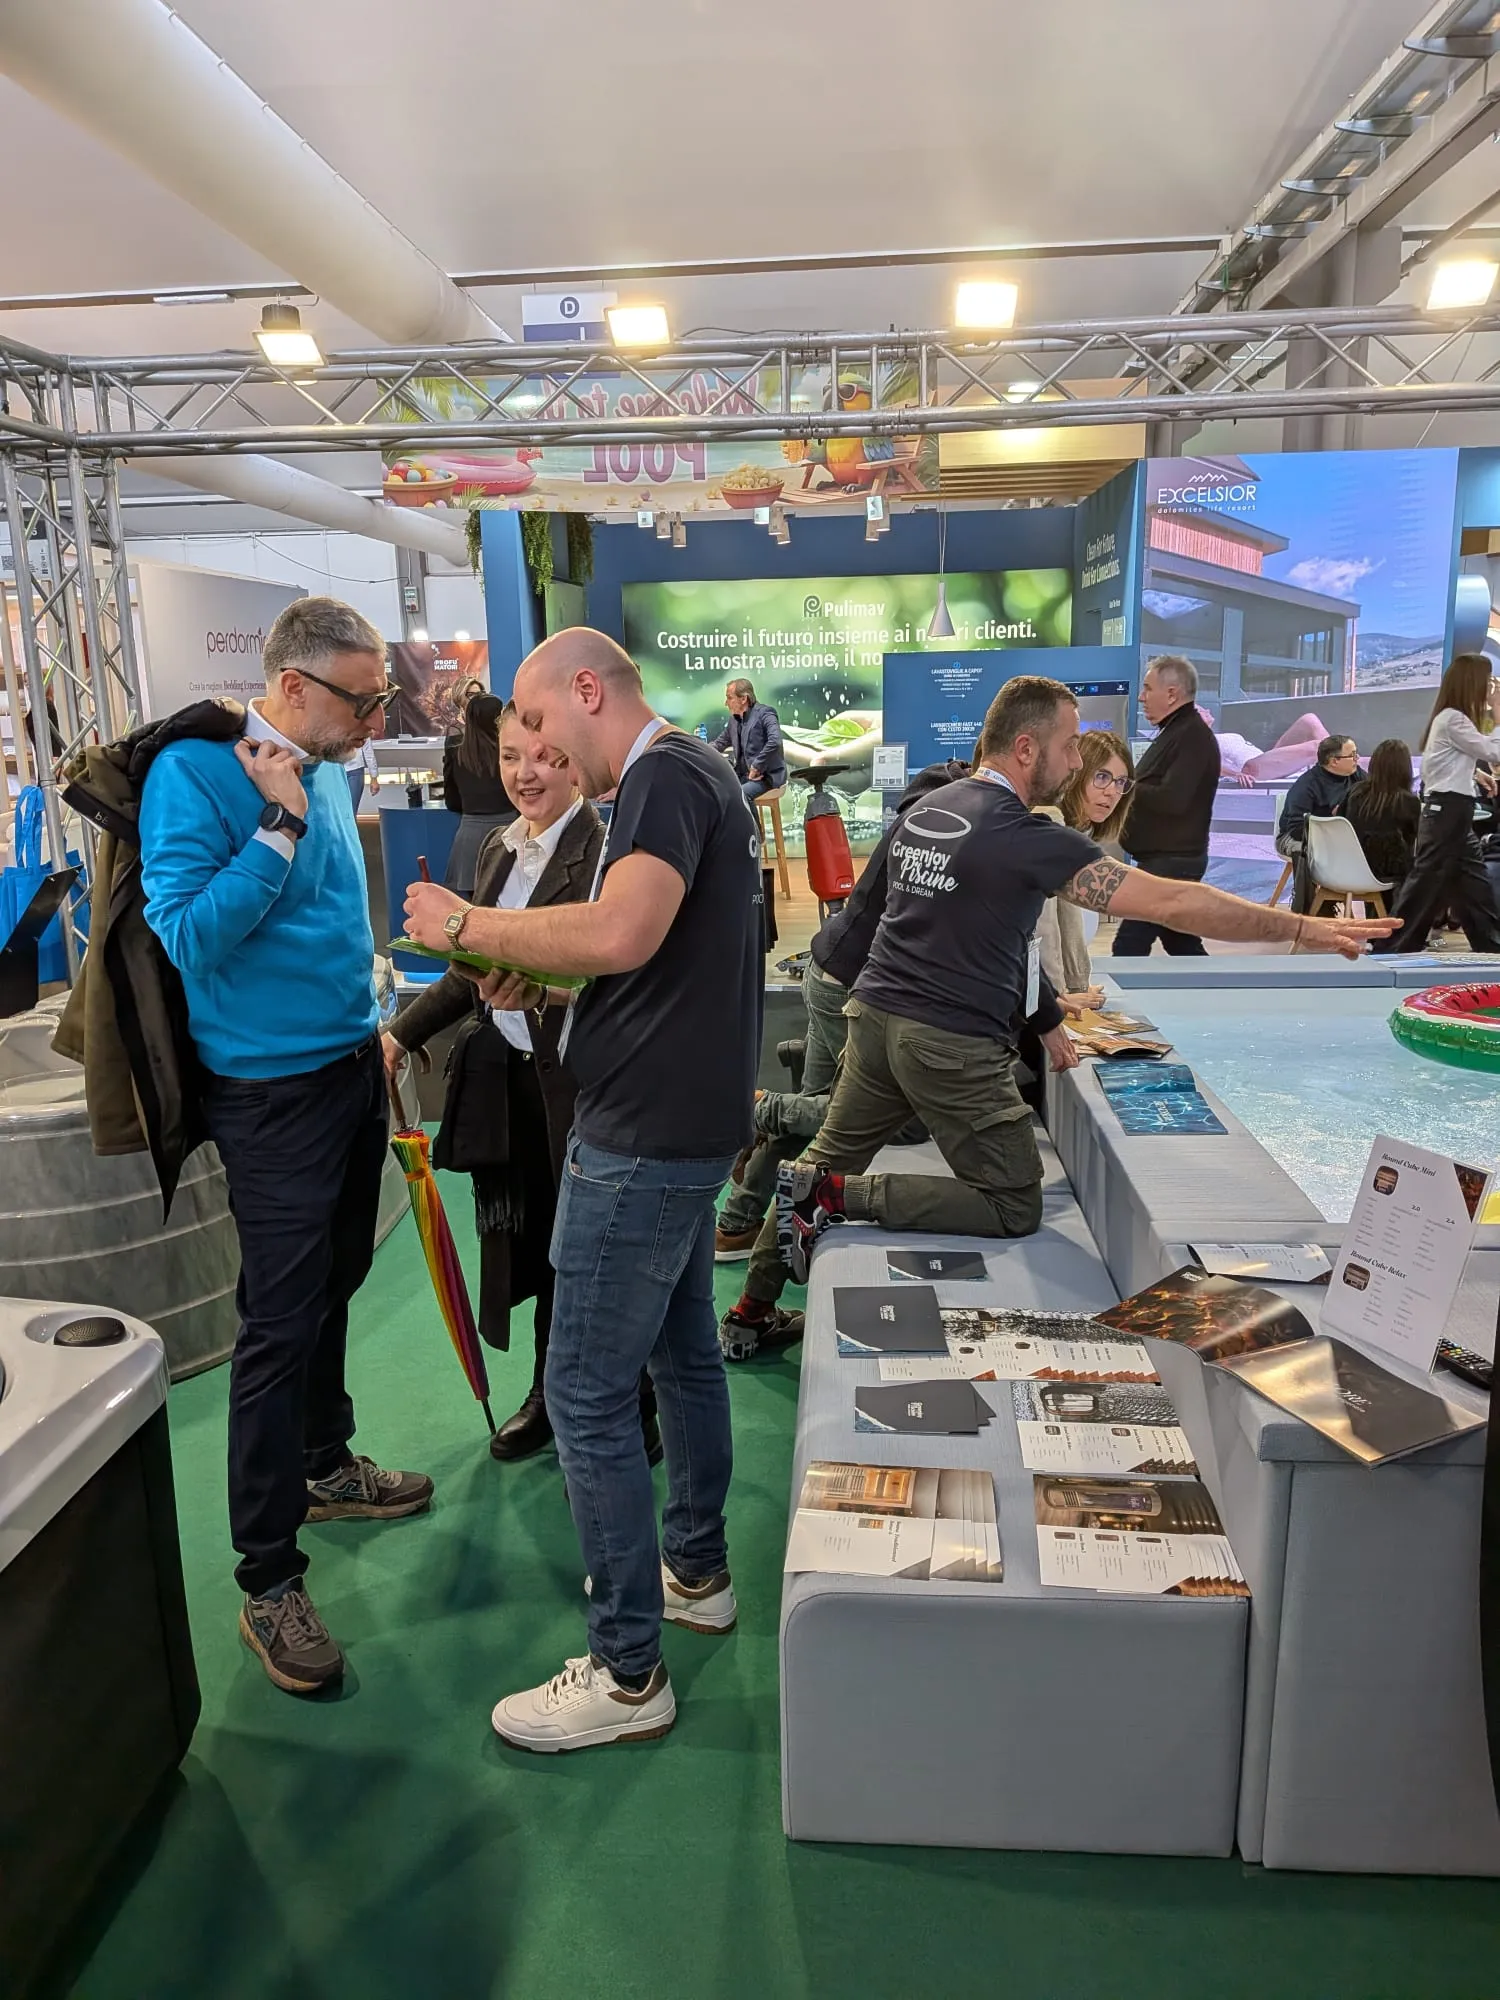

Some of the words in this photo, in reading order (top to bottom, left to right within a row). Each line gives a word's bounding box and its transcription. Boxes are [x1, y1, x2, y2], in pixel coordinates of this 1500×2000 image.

[564, 301, 576, 315] D
[1158, 485, 1256, 504] EXCELSIOR
[824, 600, 885, 617] Pulimav
[657, 629, 737, 649] Costruire
[742, 628, 754, 647] il
[758, 628, 813, 647] futuro
[819, 626, 889, 645] insieme
[894, 623, 910, 643] ai
[916, 621, 969, 642] nri
[974, 618, 1037, 640] clienti.
[684, 654, 704, 670] La
[710, 653, 765, 670] nostra
[771, 649, 839, 671] visione,
[844, 648, 855, 667] il
[892, 840, 952, 871] Greenjoy
[900, 856, 960, 892] Piscine
[892, 880, 905, 891] POOL
[911, 885, 934, 898] DREAM
[1381, 1153, 1405, 1166] Round
[1403, 1160, 1420, 1172] Cube
[1419, 1166, 1437, 1177] Mini
[1350, 1250, 1372, 1264] Round
[1371, 1259, 1388, 1270] Cube
[1387, 1266, 1408, 1279] Relax
